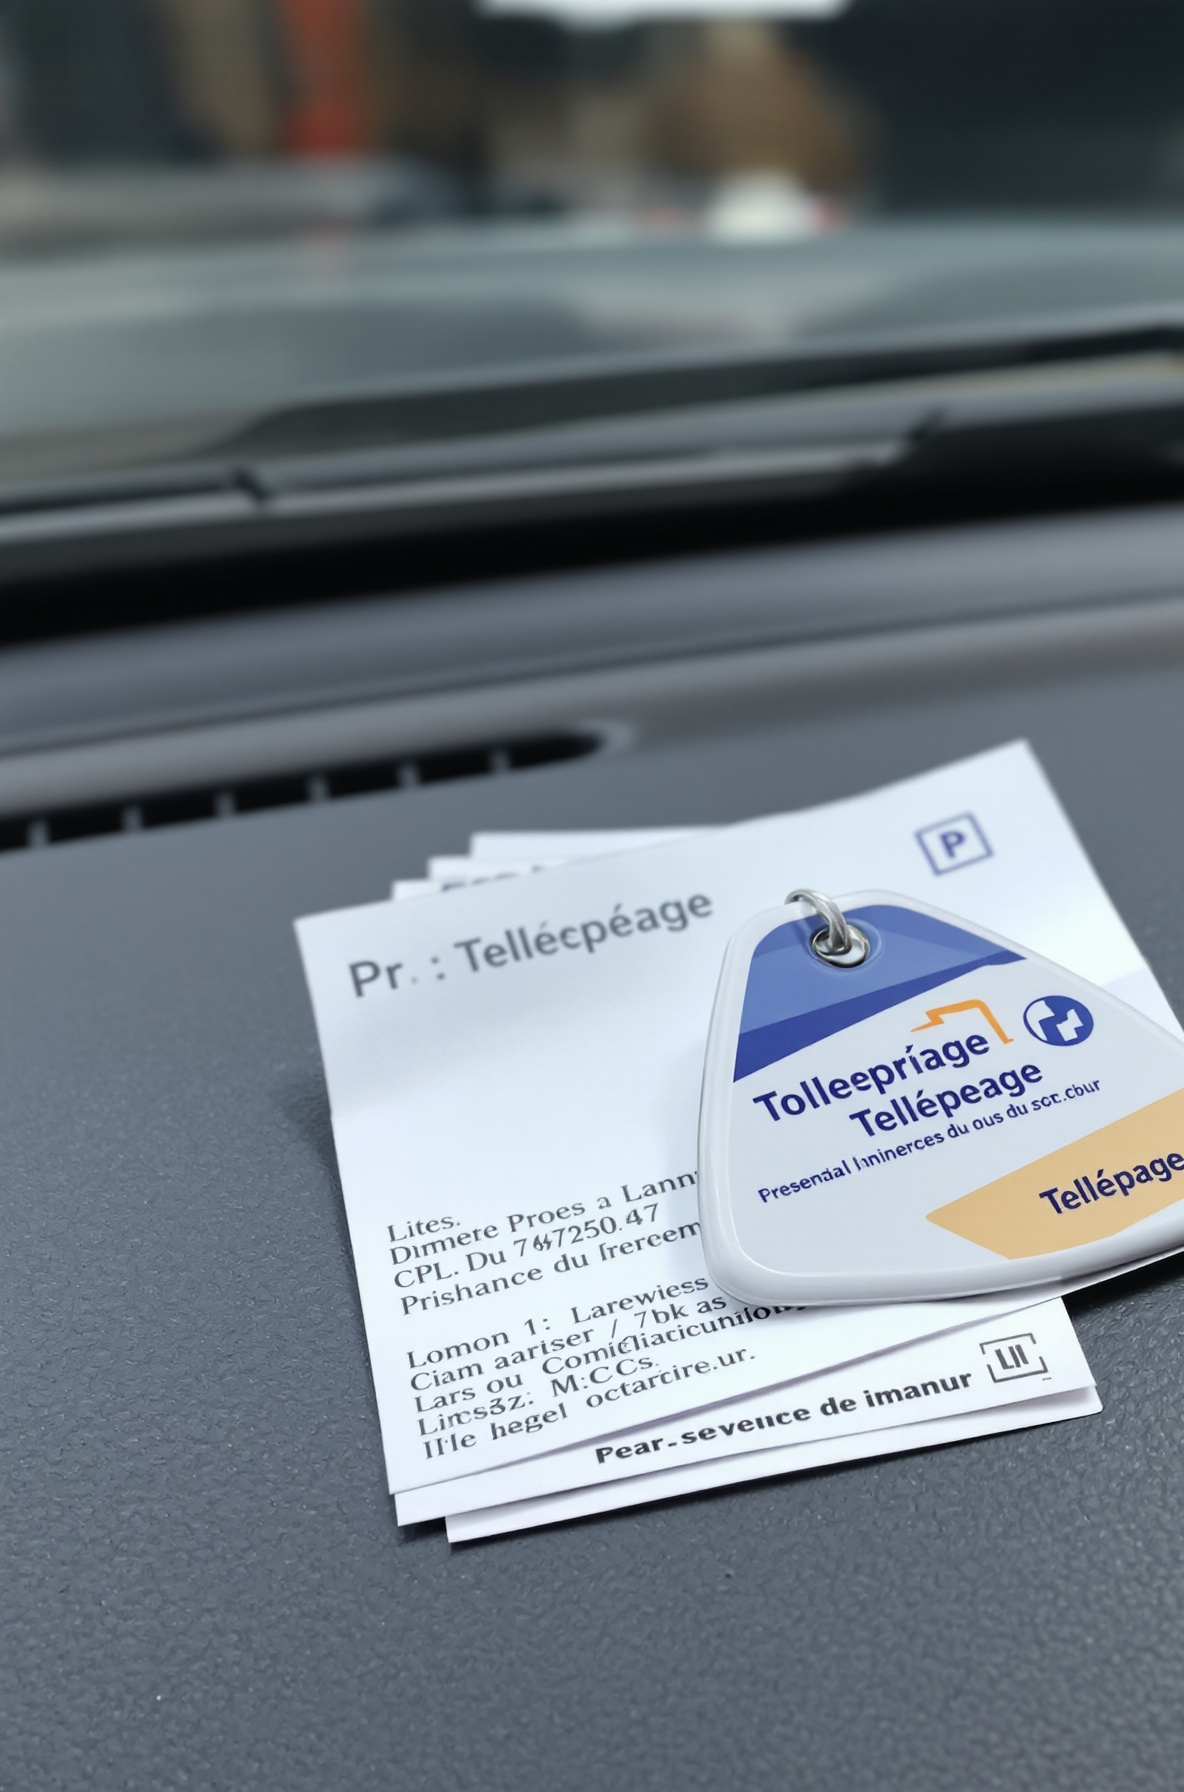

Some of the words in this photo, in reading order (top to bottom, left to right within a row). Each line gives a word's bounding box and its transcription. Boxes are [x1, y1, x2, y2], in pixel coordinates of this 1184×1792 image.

[938, 829, 967, 859] P
[848, 1063, 1043, 1138] Tellépeage
[946, 1123, 971, 1140] du
[972, 1111, 1004, 1131] ous
[1005, 1102, 1029, 1119] du
[506, 1202, 586, 1233] Proes
[596, 1196, 613, 1210] a
[621, 1171, 699, 1203] Lann
[387, 1215, 461, 1243] Lites.
[394, 1262, 459, 1288] CPL.
[465, 1250, 507, 1272] Du
[401, 1267, 544, 1316] Prishance
[553, 1253, 590, 1274] du
[697, 1296, 727, 1314] as
[407, 1331, 510, 1369] Lomon
[415, 1387, 476, 1413] Lars
[486, 1373, 523, 1393] ou
[820, 1397, 858, 1416] de
[862, 1371, 973, 1408] imanur
[489, 1402, 568, 1441] hegel
